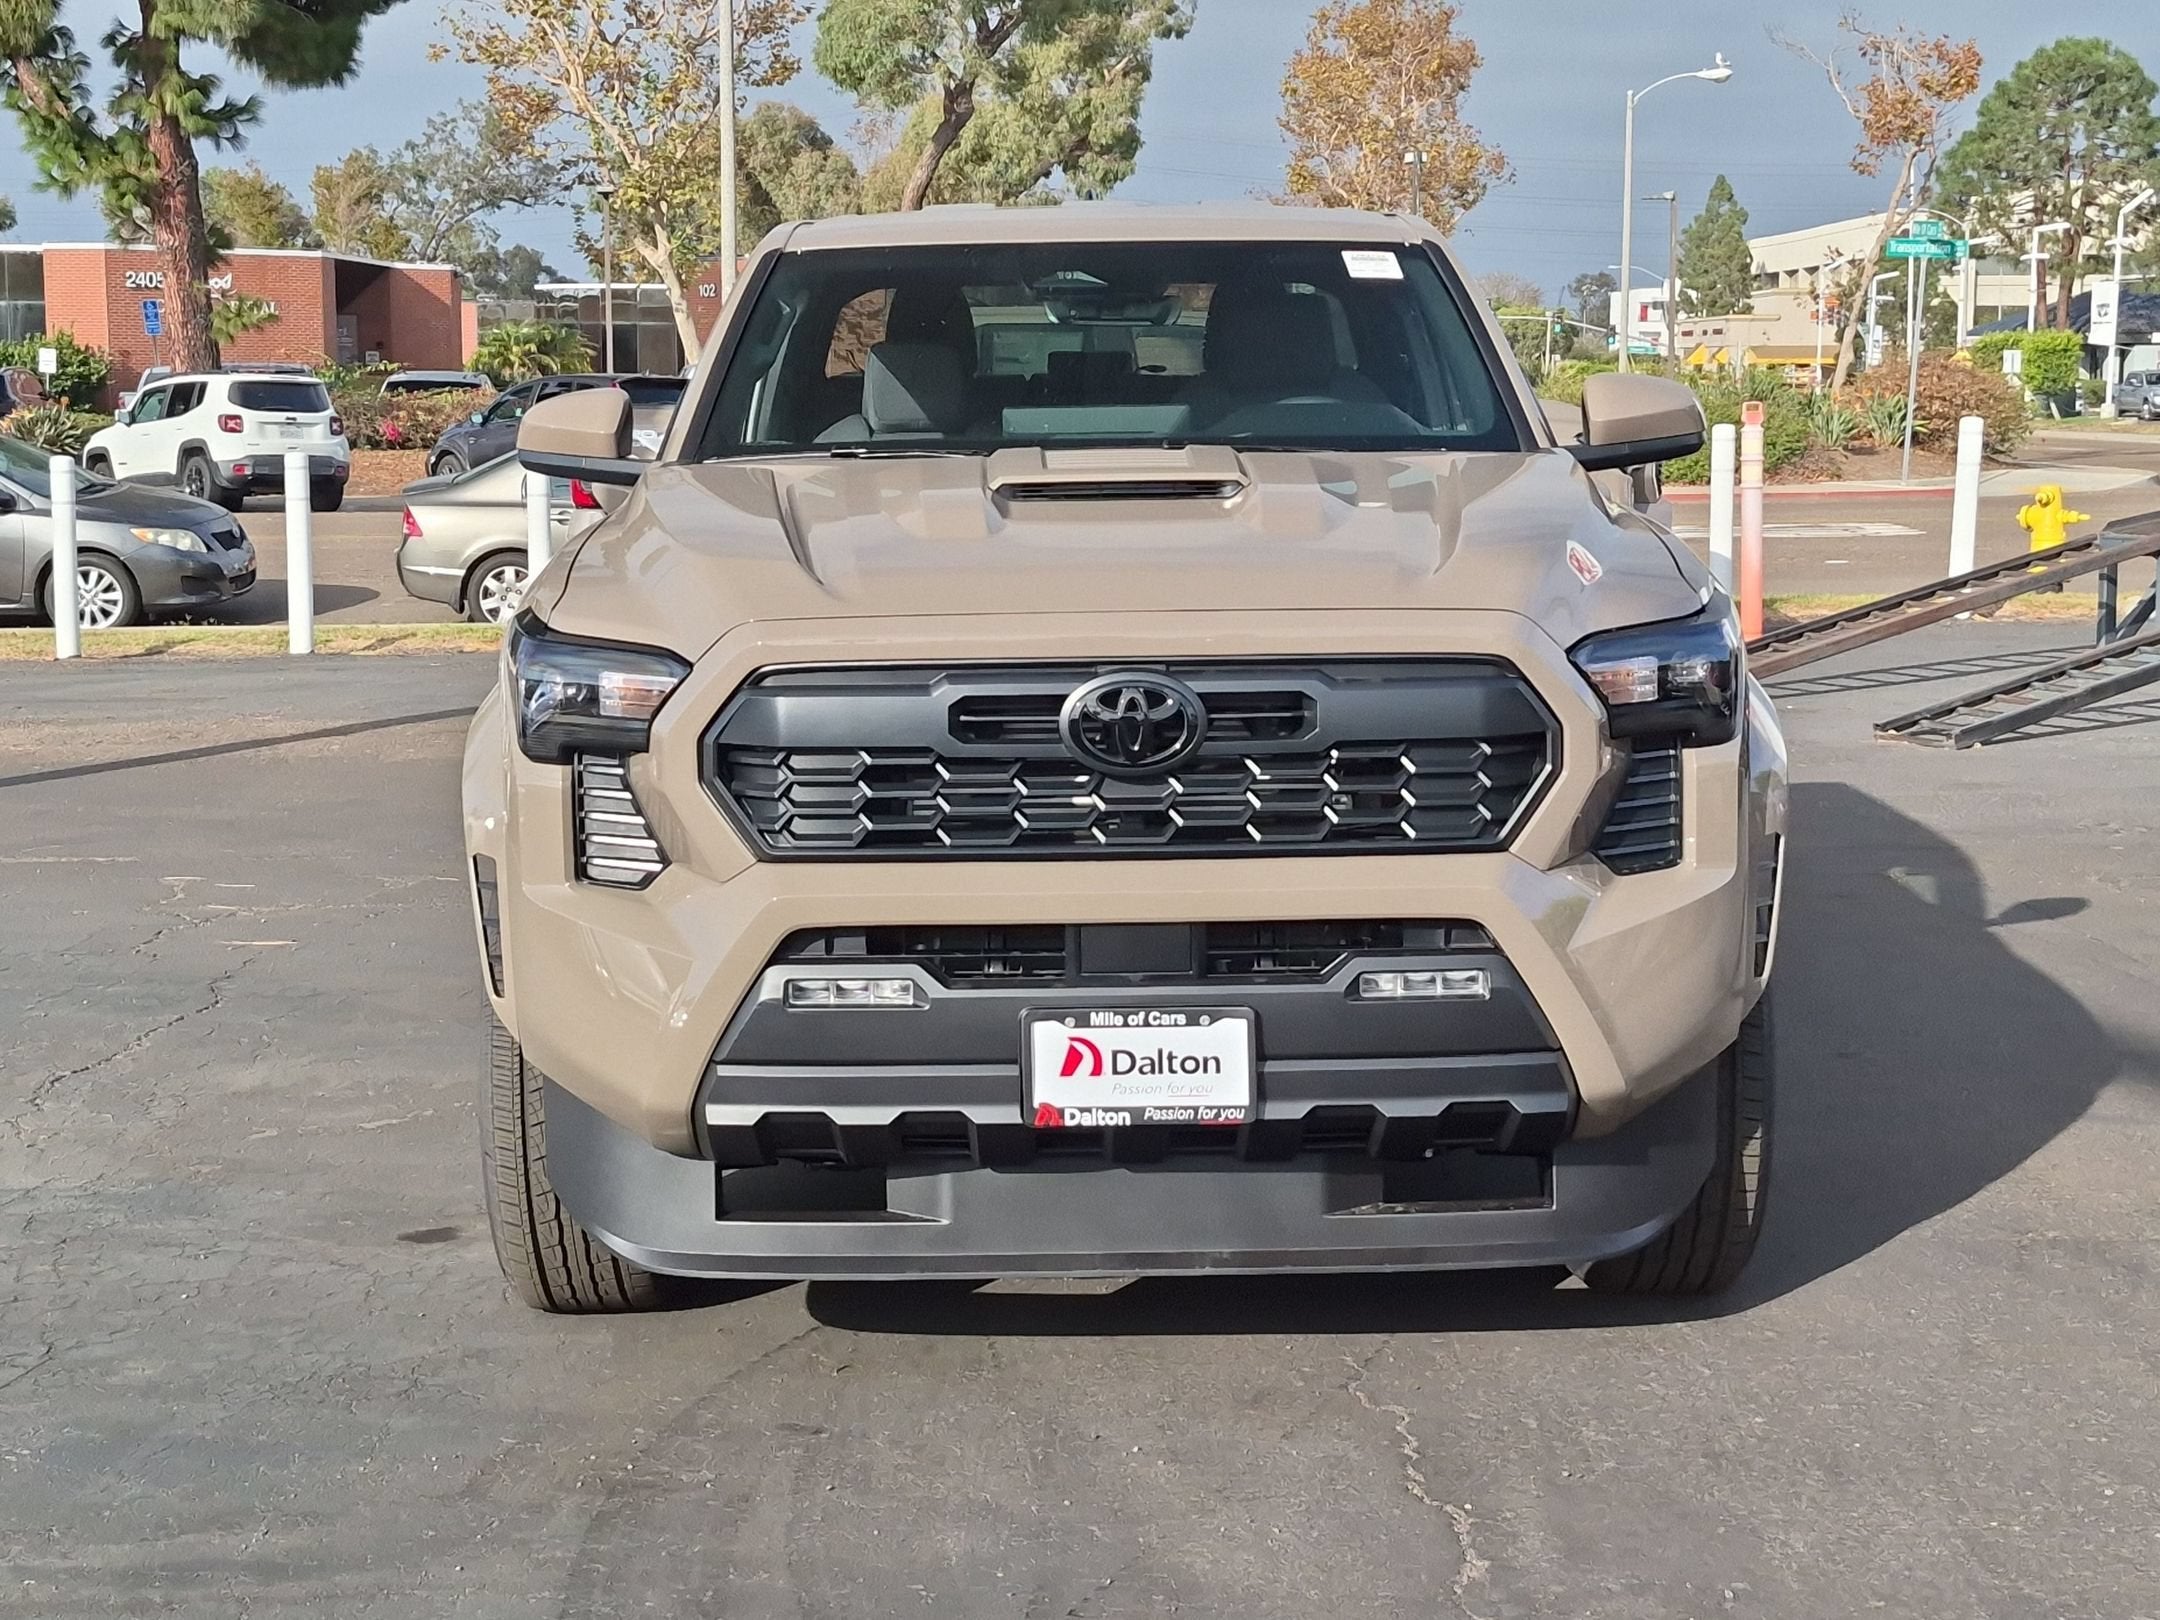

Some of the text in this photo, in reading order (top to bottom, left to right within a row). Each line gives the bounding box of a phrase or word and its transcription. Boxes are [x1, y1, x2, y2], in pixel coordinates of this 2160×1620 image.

[1889, 240, 1951, 255] Transportation
[699, 283, 716, 298] 102
[1090, 1011, 1187, 1026] Mile of Cars
[1111, 1048, 1221, 1076] Dalton
[1111, 1083, 1214, 1097] Passion for you
[1064, 1107, 1131, 1126] Dalton
[1143, 1106, 1245, 1123] Passion for you
